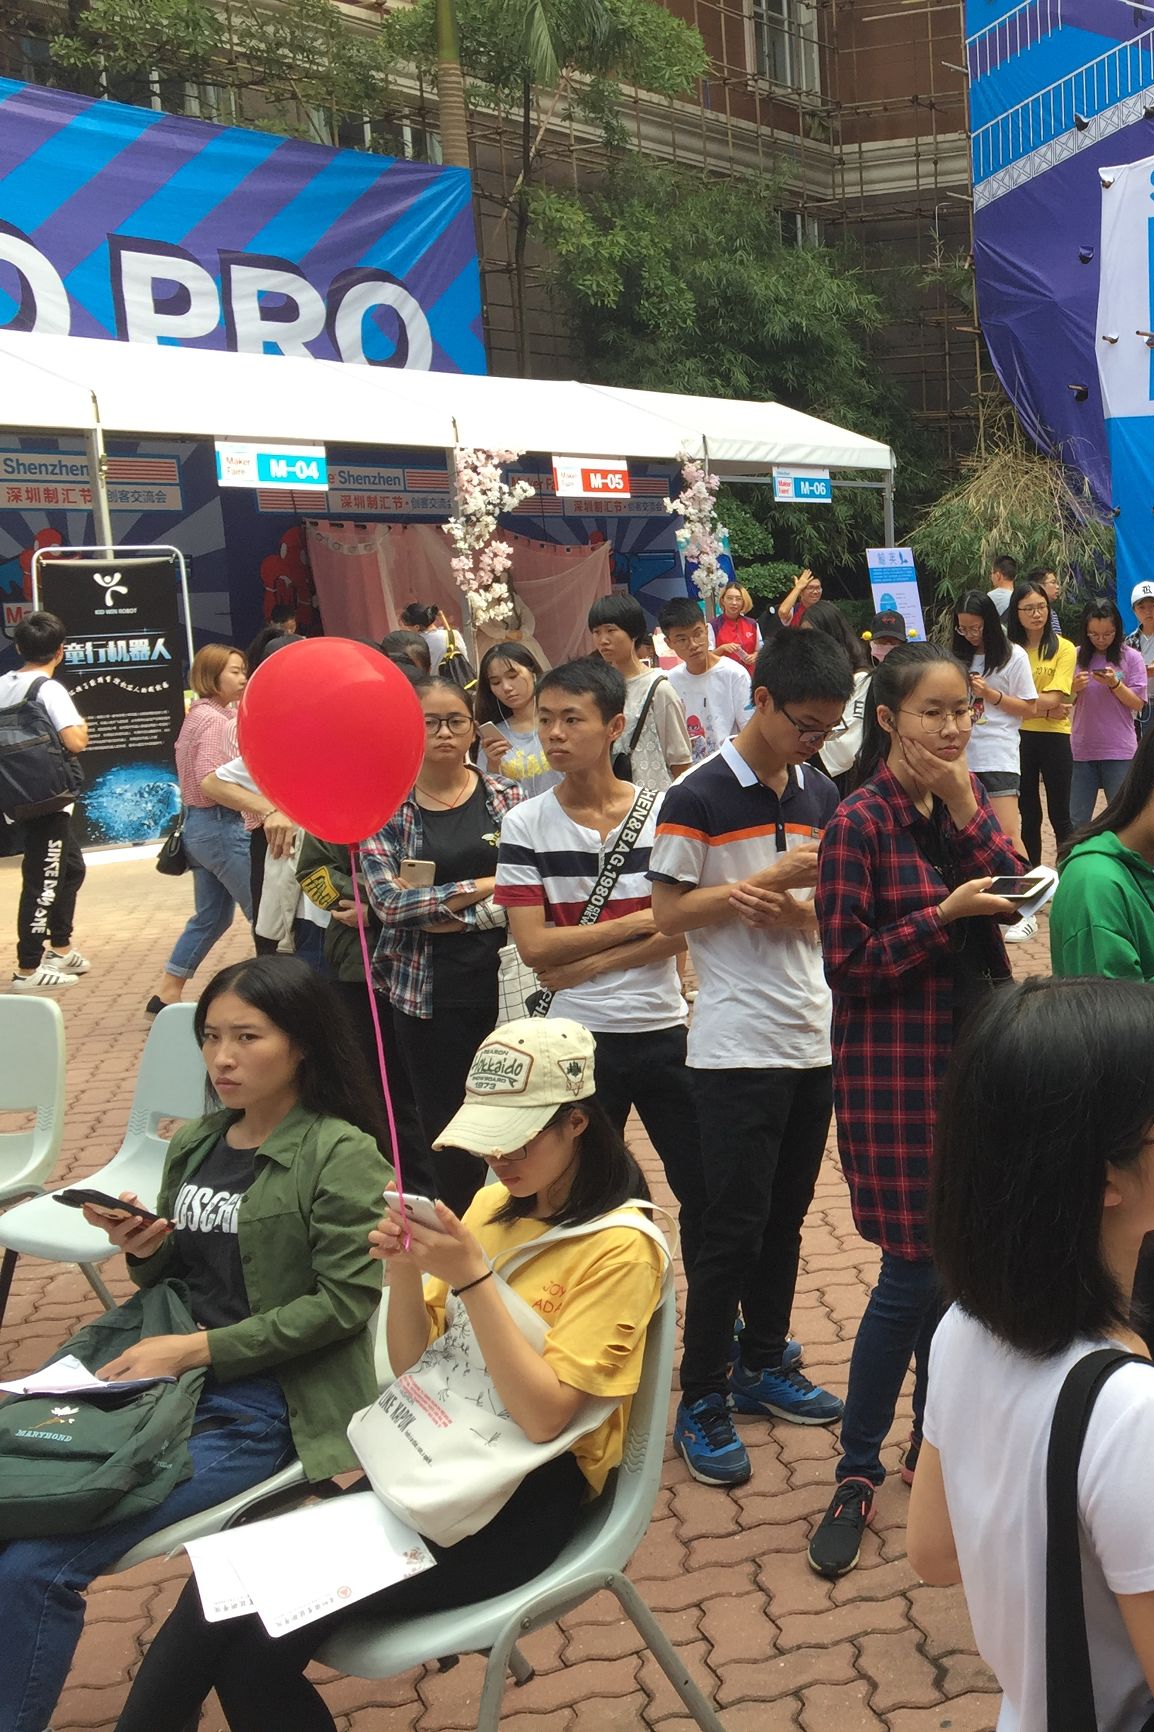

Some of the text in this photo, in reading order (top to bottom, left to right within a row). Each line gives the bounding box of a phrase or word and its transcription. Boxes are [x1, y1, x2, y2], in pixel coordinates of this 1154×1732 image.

[112, 240, 433, 371] PRO
[3, 457, 89, 477] Shenzhen
[269, 458, 319, 480] M-04
[338, 470, 401, 487] Shenzhen
[589, 472, 624, 490] M-05
[800, 481, 827, 496] M-06
[63, 637, 173, 666] 童行机器人
